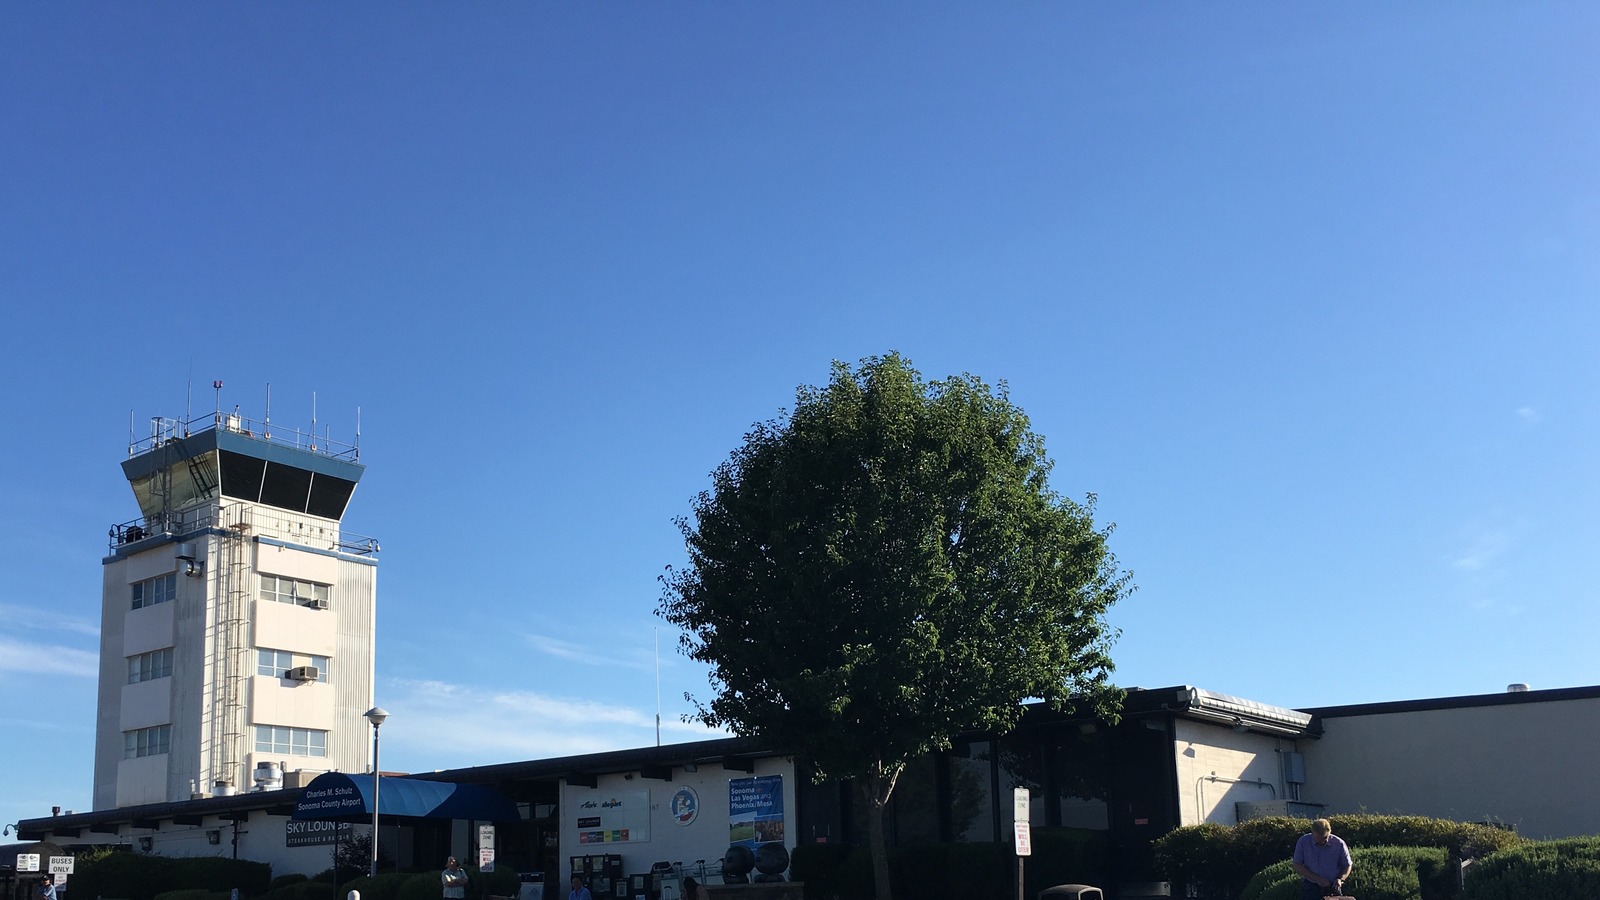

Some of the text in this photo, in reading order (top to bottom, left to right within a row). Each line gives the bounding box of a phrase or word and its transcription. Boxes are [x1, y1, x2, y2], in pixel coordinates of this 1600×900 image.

[306, 790, 326, 798] Charles
[335, 787, 352, 795] Schulz
[298, 798, 360, 810] Sonoma County Airport
[731, 800, 773, 809] Phoenix/Mesa
[286, 822, 306, 834] SKY
